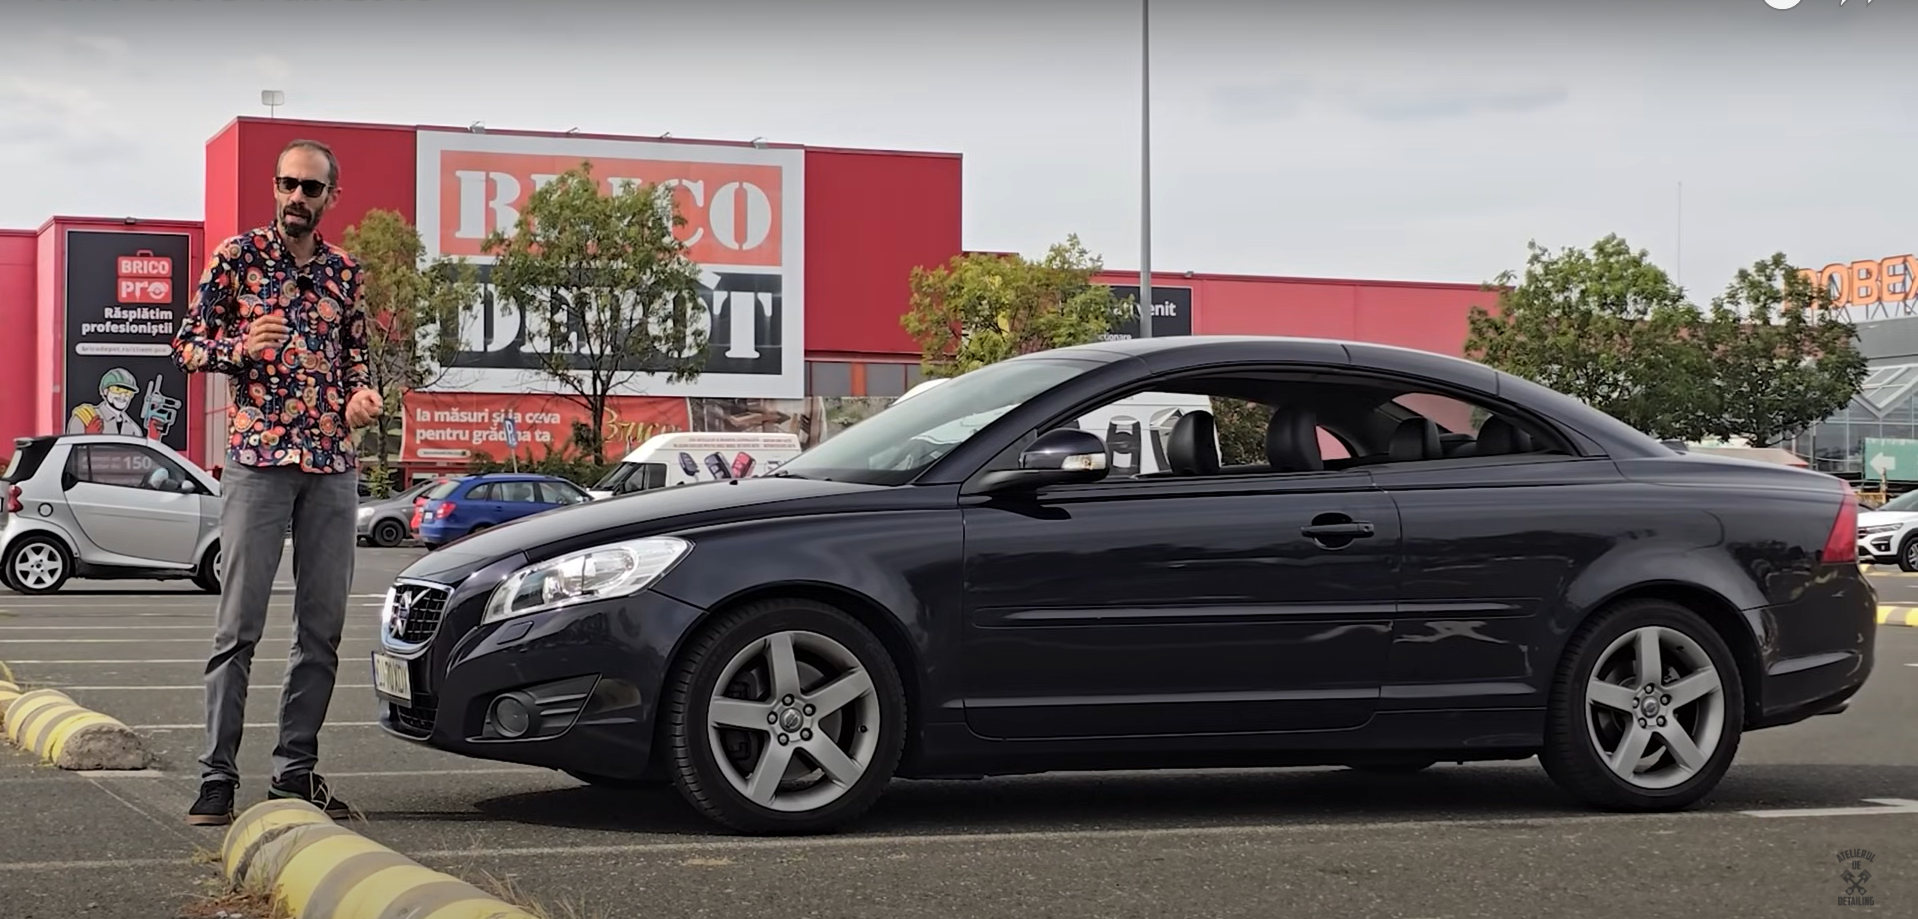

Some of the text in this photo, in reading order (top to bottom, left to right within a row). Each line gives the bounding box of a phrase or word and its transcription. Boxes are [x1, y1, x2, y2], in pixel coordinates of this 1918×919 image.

[455, 170, 772, 251] BCO
[121, 260, 169, 275] BRICO
[104, 307, 173, 322] Răsplătim
[81, 321, 173, 336] profesioniștii
[434, 407, 489, 423] măsuri
[525, 411, 561, 425] ceva
[416, 428, 470, 444] pentru
[472, 422, 532, 445] grădna
[123, 456, 152, 470] 150
